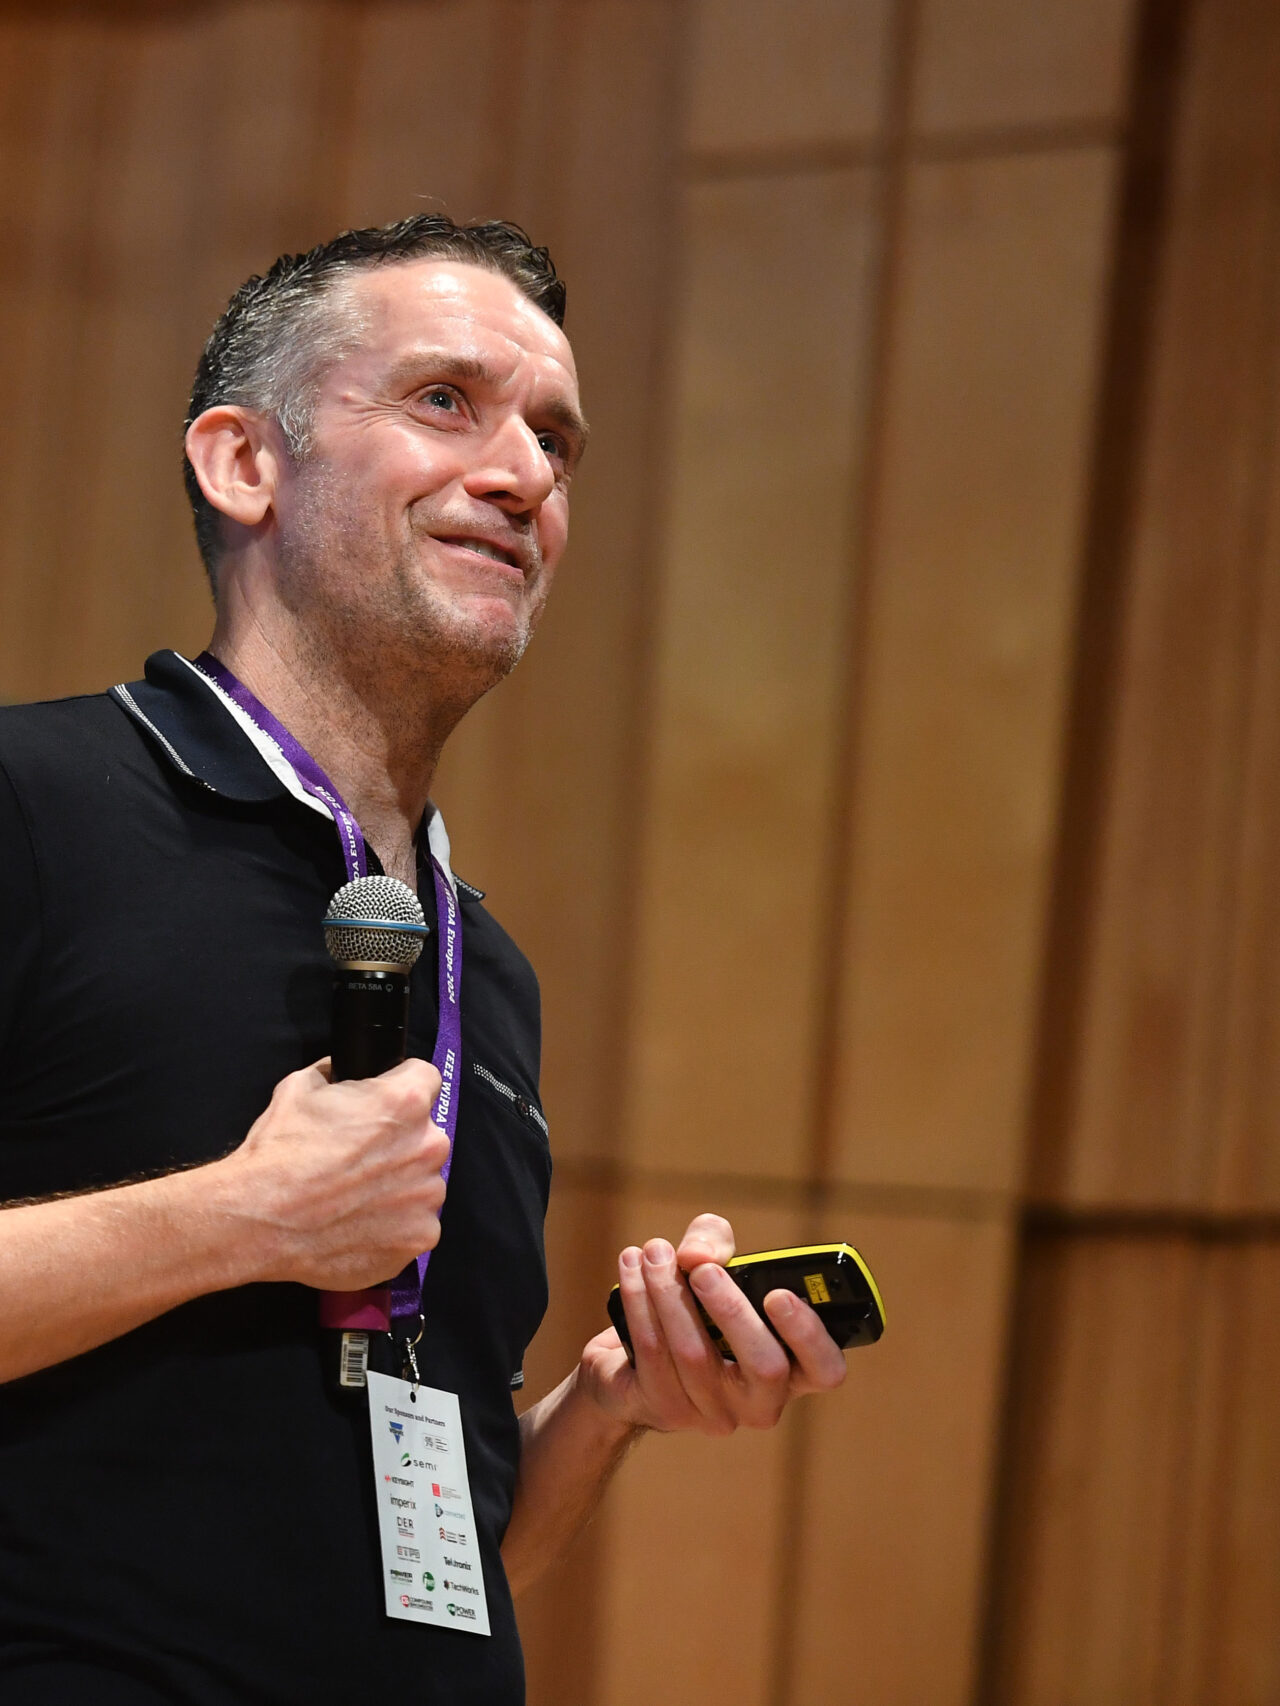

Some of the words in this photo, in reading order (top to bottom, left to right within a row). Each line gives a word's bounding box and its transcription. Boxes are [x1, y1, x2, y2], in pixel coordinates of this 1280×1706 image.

[314, 786, 342, 810] 2024
[445, 926, 456, 972] Europe
[446, 972, 456, 1004] 2024
[443, 1048, 455, 1080] IEEE
[436, 1082, 451, 1123] WiPDA
